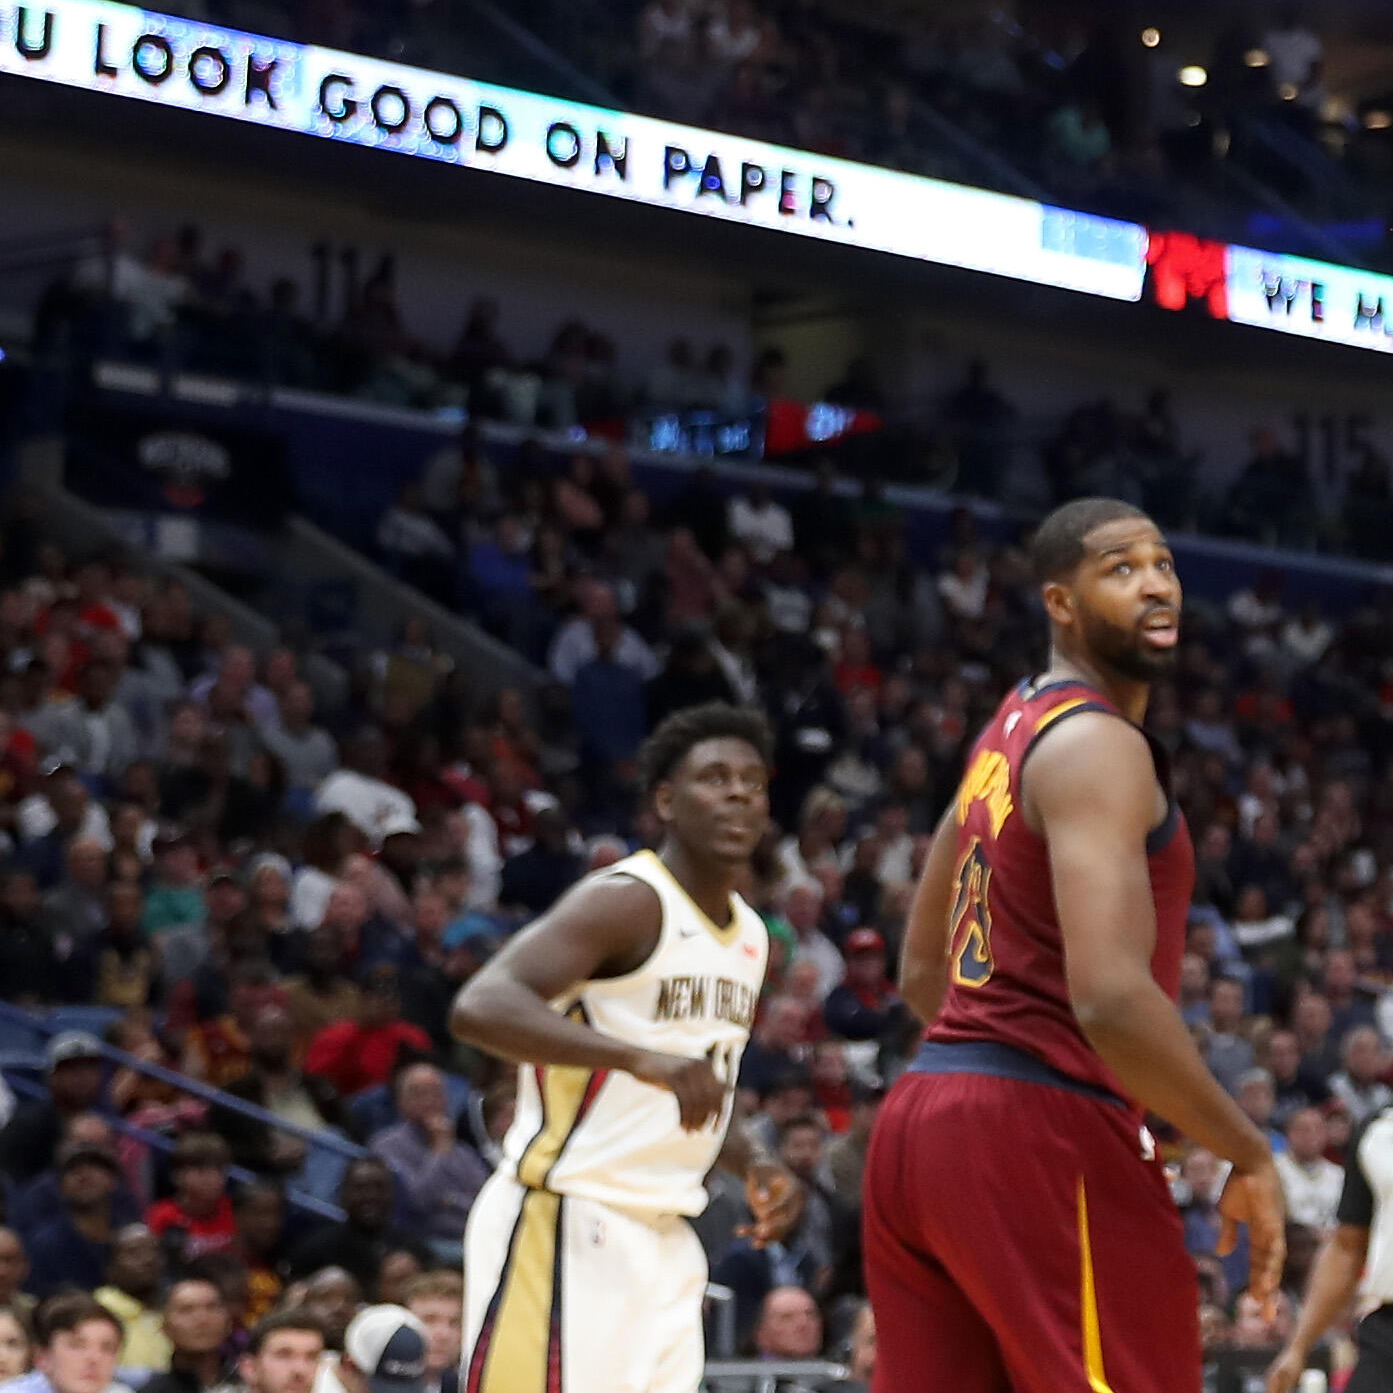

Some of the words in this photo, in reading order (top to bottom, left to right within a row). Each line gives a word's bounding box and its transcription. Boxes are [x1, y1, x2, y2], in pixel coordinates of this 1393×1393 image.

[95, 22, 279, 110] LOOK
[318, 73, 510, 155] GOOD
[545, 121, 630, 182] ON
[663, 144, 856, 230] PAPER.
[1257, 265, 1326, 323] WE
[655, 975, 705, 1023] NEW
